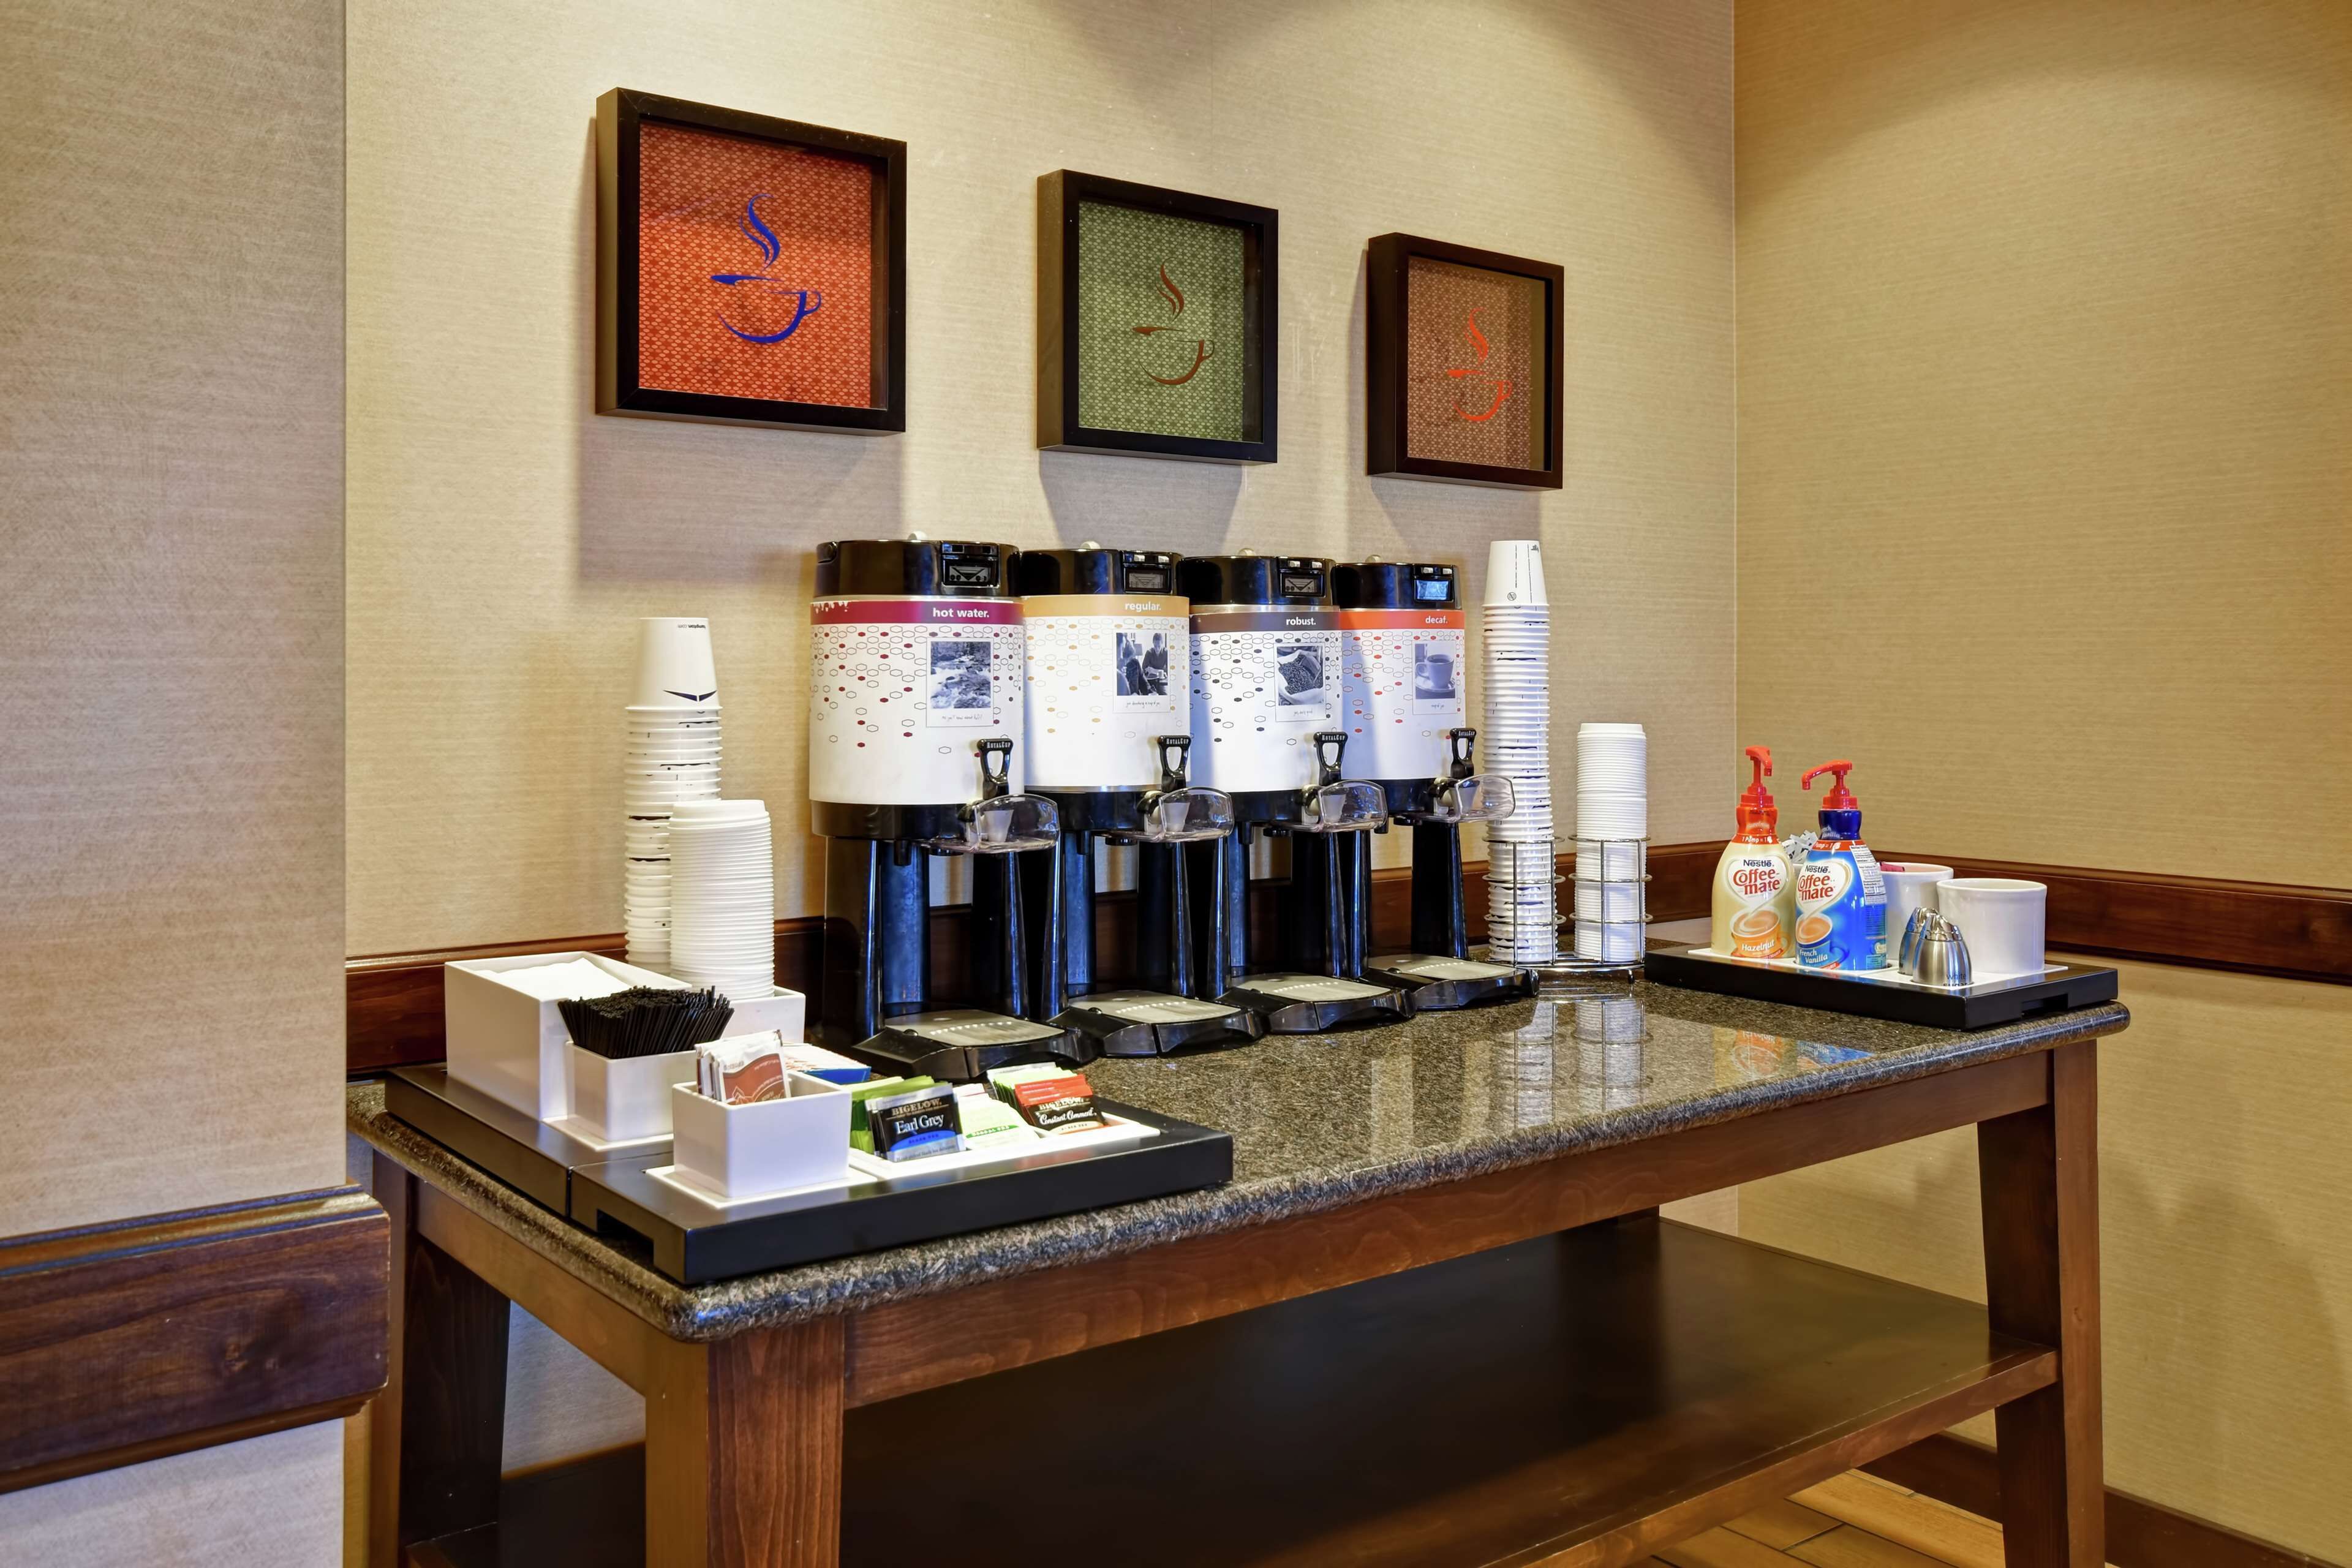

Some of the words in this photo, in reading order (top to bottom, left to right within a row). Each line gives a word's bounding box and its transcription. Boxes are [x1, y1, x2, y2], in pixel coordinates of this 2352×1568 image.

[1125, 601, 1161, 612] regular.
[933, 607, 954, 617] hot
[957, 608, 990, 618] water.
[1286, 616, 1316, 625] robust.
[1425, 615, 1448, 624] decaf.
[1744, 879, 1781, 895] mate
[1801, 886, 1834, 901] mate
[1741, 940, 1774, 952] Hazelnut
[1805, 953, 1828, 963] Vanilla
[891, 1098, 942, 1116] BIGELOW
[895, 1117, 918, 1134] Earl
[919, 1114, 944, 1128] Grey
